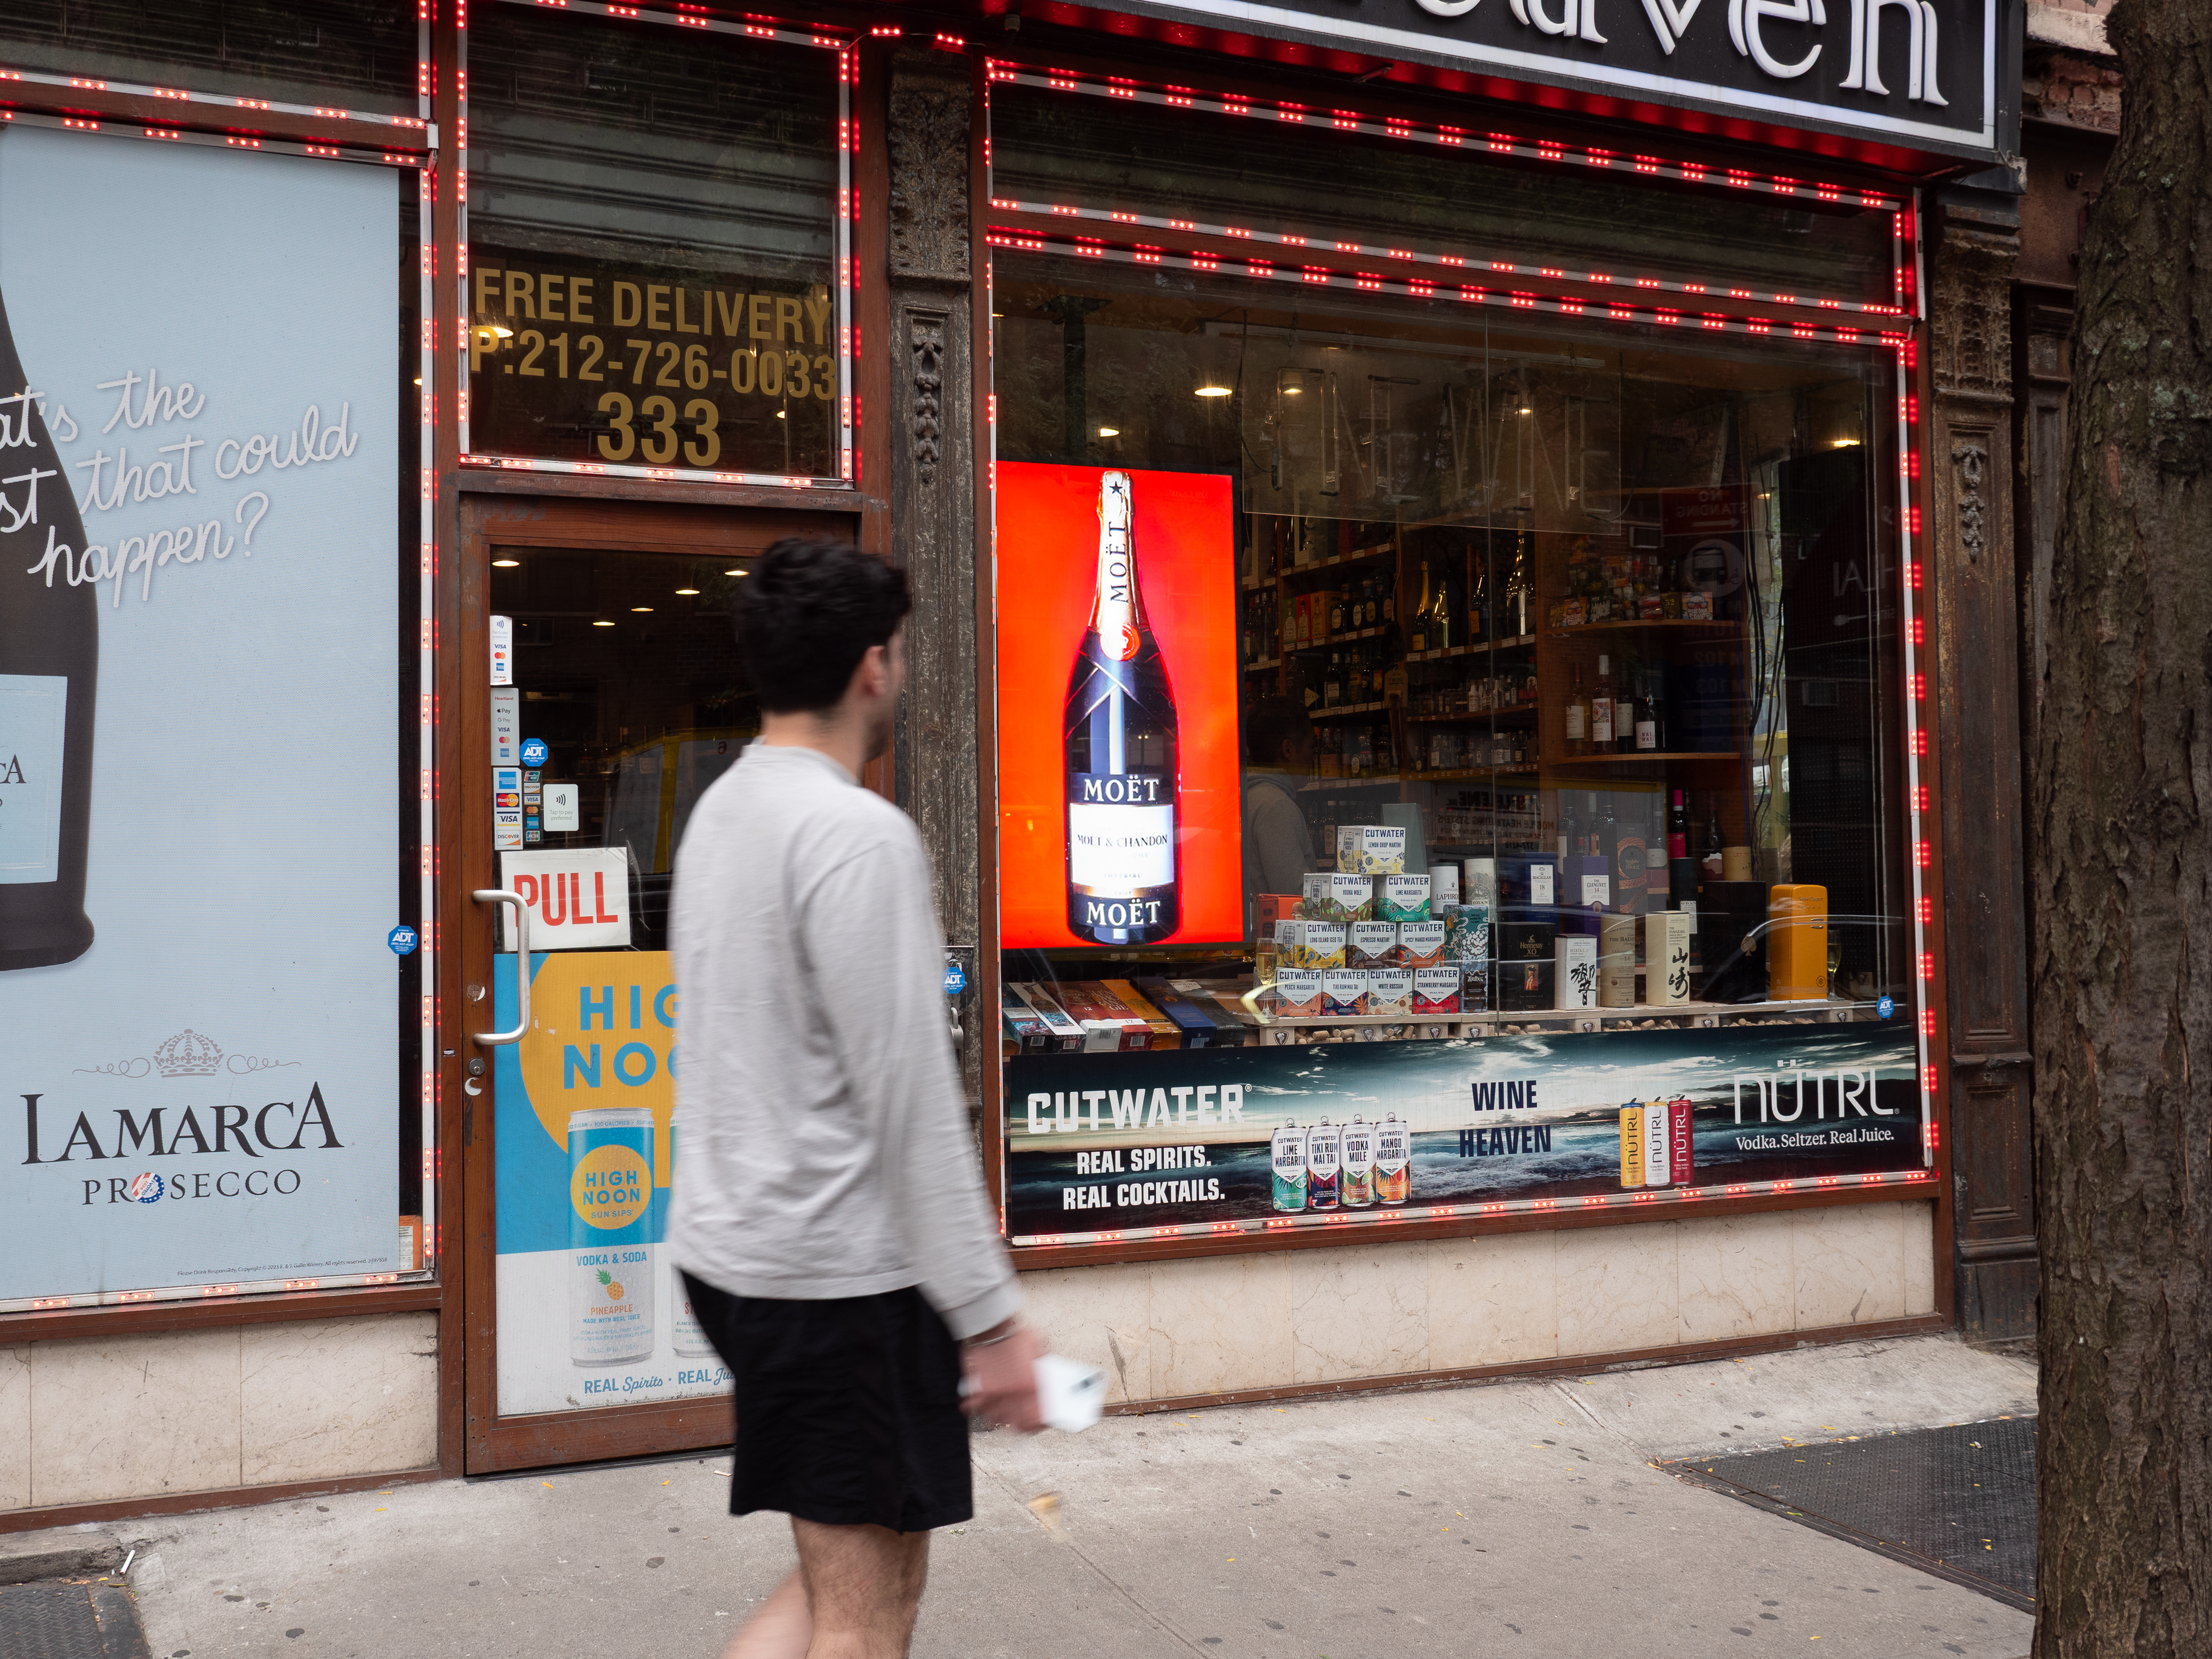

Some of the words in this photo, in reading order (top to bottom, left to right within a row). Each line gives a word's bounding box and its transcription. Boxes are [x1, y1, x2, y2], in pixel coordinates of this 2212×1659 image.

[476, 267, 594, 324] FREE
[613, 281, 832, 345] DELIVERY
[470, 325, 837, 401] P:212-726-0033
[97, 368, 205, 434] the
[597, 392, 720, 467] 333
[76, 434, 205, 514] that
[215, 402, 358, 479] could
[27, 491, 270, 608] happen?
[1106, 522, 1129, 603] MOËT
[523, 746, 544, 756] ADT
[1084, 774, 1159, 802] MOËT
[1117, 834, 1168, 848] CHANDON
[514, 871, 618, 928] PULL
[1086, 898, 1160, 926] MOËT
[1307, 924, 1344, 933] CUTWATER
[1356, 924, 1395, 933] CUTWATER
[1403, 923, 1443, 933] CUTWATER
[392, 932, 414, 943] ADT
[945, 974, 962, 985] ADT
[1280, 971, 1320, 980] CUTWATER
[1370, 971, 1411, 979] CUTWATER
[579, 983, 681, 1031] HIG
[1879, 1000, 1891, 1009] ADT
[563, 1042, 681, 1089] NO
[1472, 1080, 1537, 1111] WINE
[20, 1081, 345, 1165] LAMARCA
[1312, 1143, 1323, 1154] TIKI
[1325, 1142, 1338, 1153] RUM
[1347, 1140, 1369, 1151] VODKA
[1381, 1139, 1402, 1149] MANGO
[1459, 1125, 1552, 1158] HEAVEN
[1736, 1135, 1780, 1151] Vodka.
[1781, 1132, 1827, 1148] Seltzer.
[1829, 1129, 1858, 1144] Real
[1858, 1128, 1895, 1142] Juice.
[1283, 1145, 1297, 1155] LIME
[1349, 1152, 1367, 1162] MULE
[1377, 1149, 1406, 1160] MARGARITA
[1077, 1150, 1124, 1175] REAL
[1131, 1146, 1212, 1171] SPIRITS.
[1275, 1155, 1306, 1168] MARGARITA
[1314, 1154, 1325, 1165] MAI
[1326, 1154, 1336, 1164] TAI
[82, 1169, 301, 1205] PRSECCO
[586, 1170, 637, 1188] HIGH
[141, 1183, 152, 1195] VOTED
[583, 1188, 640, 1205] NOON
[1063, 1185, 1111, 1210] REAL
[1117, 1178, 1225, 1207] COCKTAILS.
[577, 1254, 608, 1266] VODKA
[612, 1253, 619, 1264] &
[623, 1251, 647, 1263] SODA
[591, 1304, 633, 1315] PINEAPPLE
[585, 1378, 619, 1394] REAL
[622, 1376, 663, 1394] Spirits
[678, 1369, 712, 1385] REAL
